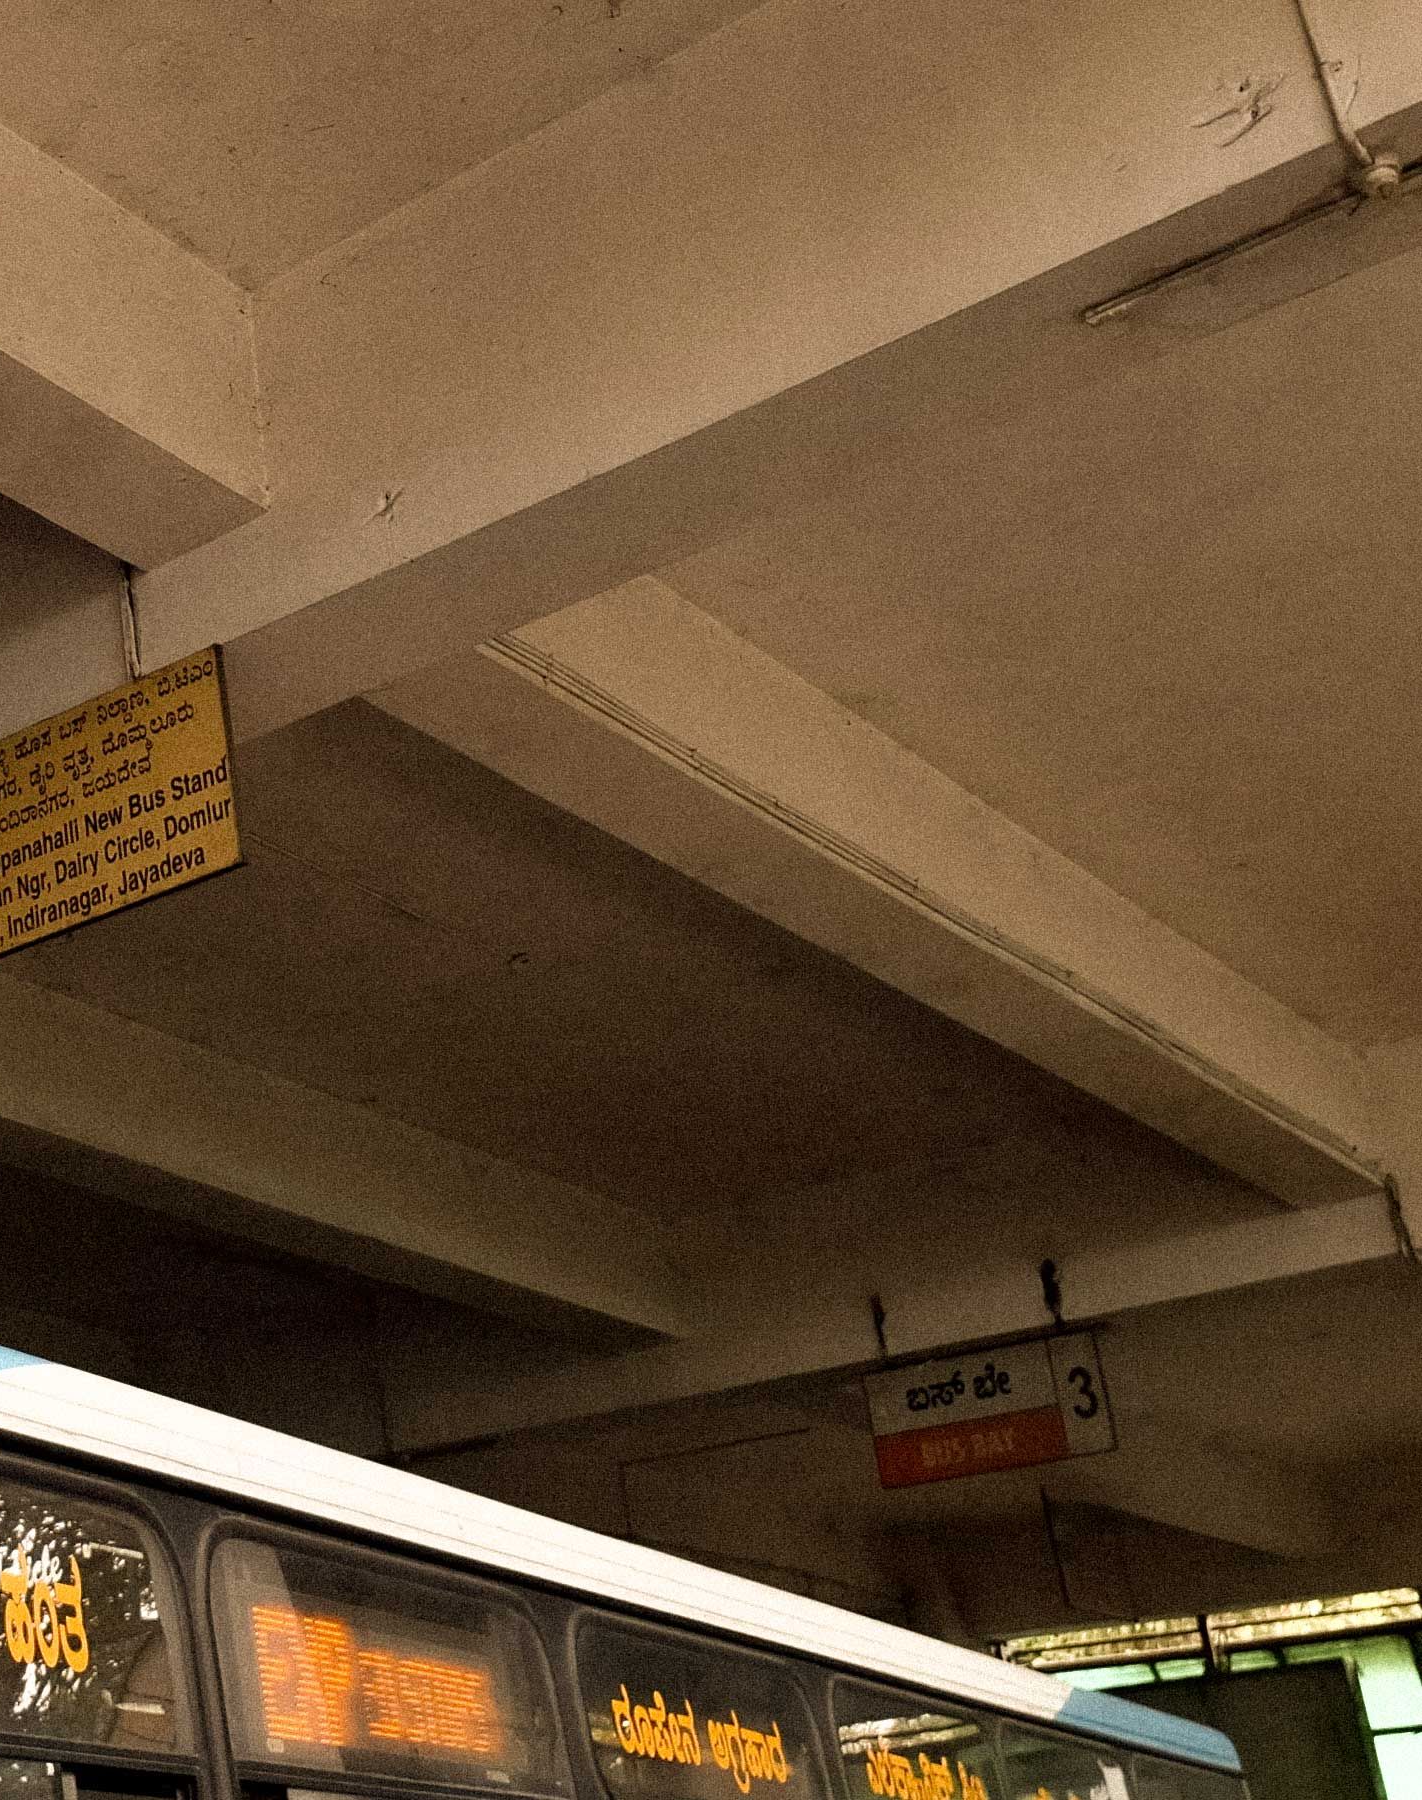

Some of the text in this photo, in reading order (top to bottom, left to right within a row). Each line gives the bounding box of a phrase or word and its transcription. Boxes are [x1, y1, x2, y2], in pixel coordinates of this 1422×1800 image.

[14, 729, 51, 760] ಹೊಸ
[58, 710, 87, 740] ಬಸ್
[83, 805, 123, 837] New
[127, 789, 166, 819] Bus
[170, 756, 228, 801] Stand
[16, 871, 51, 900] Ngr,
[53, 850, 99, 885] Dairy
[103, 828, 160, 864] Circle,
[163, 798, 231, 841] Domlur
[7, 883, 113, 930] Indiranagar,
[117, 846, 205, 896] Jayadeva
[906, 1362, 1012, 1412] ಬಸ್ ಬೇ
[1067, 1366, 1099, 1420] 3
